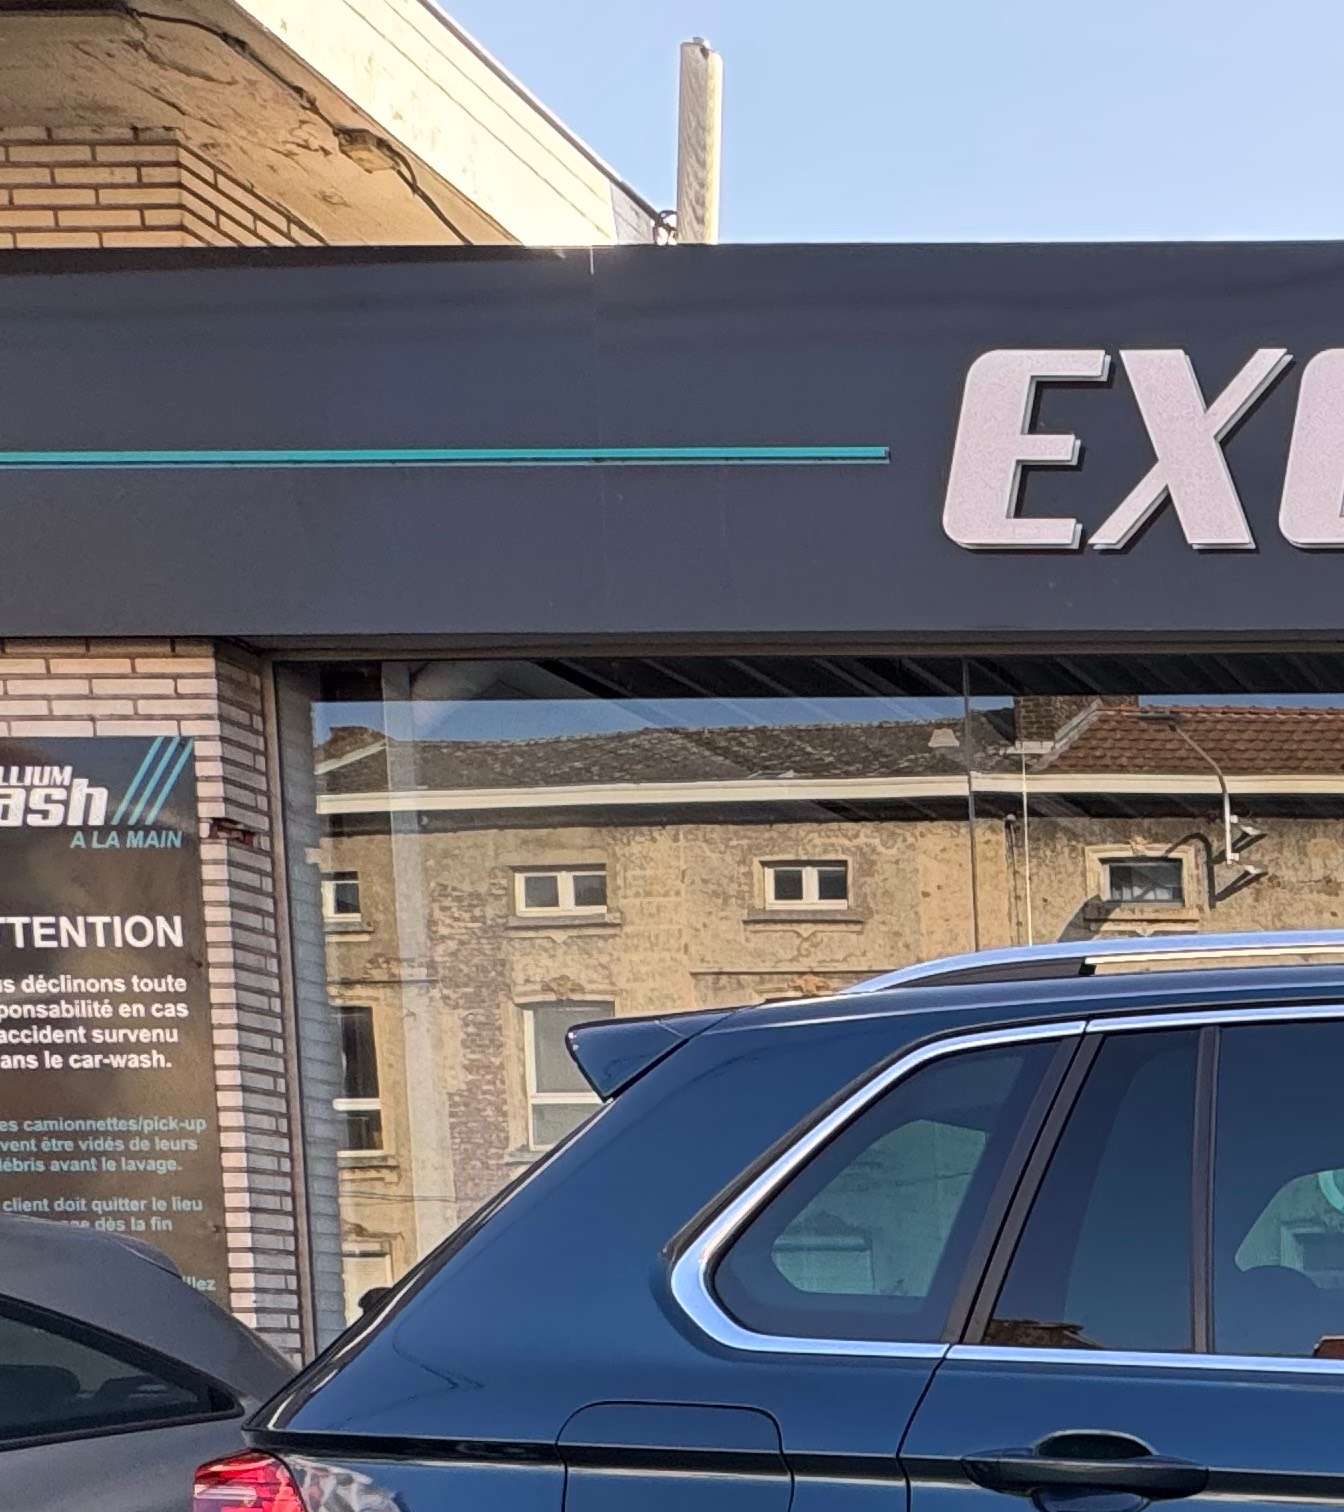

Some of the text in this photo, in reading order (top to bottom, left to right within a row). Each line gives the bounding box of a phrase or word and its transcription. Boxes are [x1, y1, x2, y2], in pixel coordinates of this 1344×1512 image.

[70, 831, 182, 848] A LA MAIN
[0, 915, 183, 948] TENTION
[21, 974, 126, 994] déclinons
[131, 974, 187, 993] toute
[119, 1003, 145, 1018] en
[151, 1003, 189, 1018] cas
[92, 1028, 178, 1044] survenu
[1, 1050, 172, 1069] ans le car-wash.
[41, 1137, 74, 1151] être
[78, 1136, 125, 1151] vidés
[129, 1136, 150, 1151] de
[155, 1137, 198, 1151] leurs
[50, 1158, 98, 1172] avant
[102, 1157, 116, 1171] le
[122, 1157, 183, 1174] lavage.
[3, 1197, 203, 1214] client doit quitter le lieu
[95, 1216, 126, 1231] dès
[131, 1216, 146, 1231] la
[151, 1216, 173, 1231] fin
